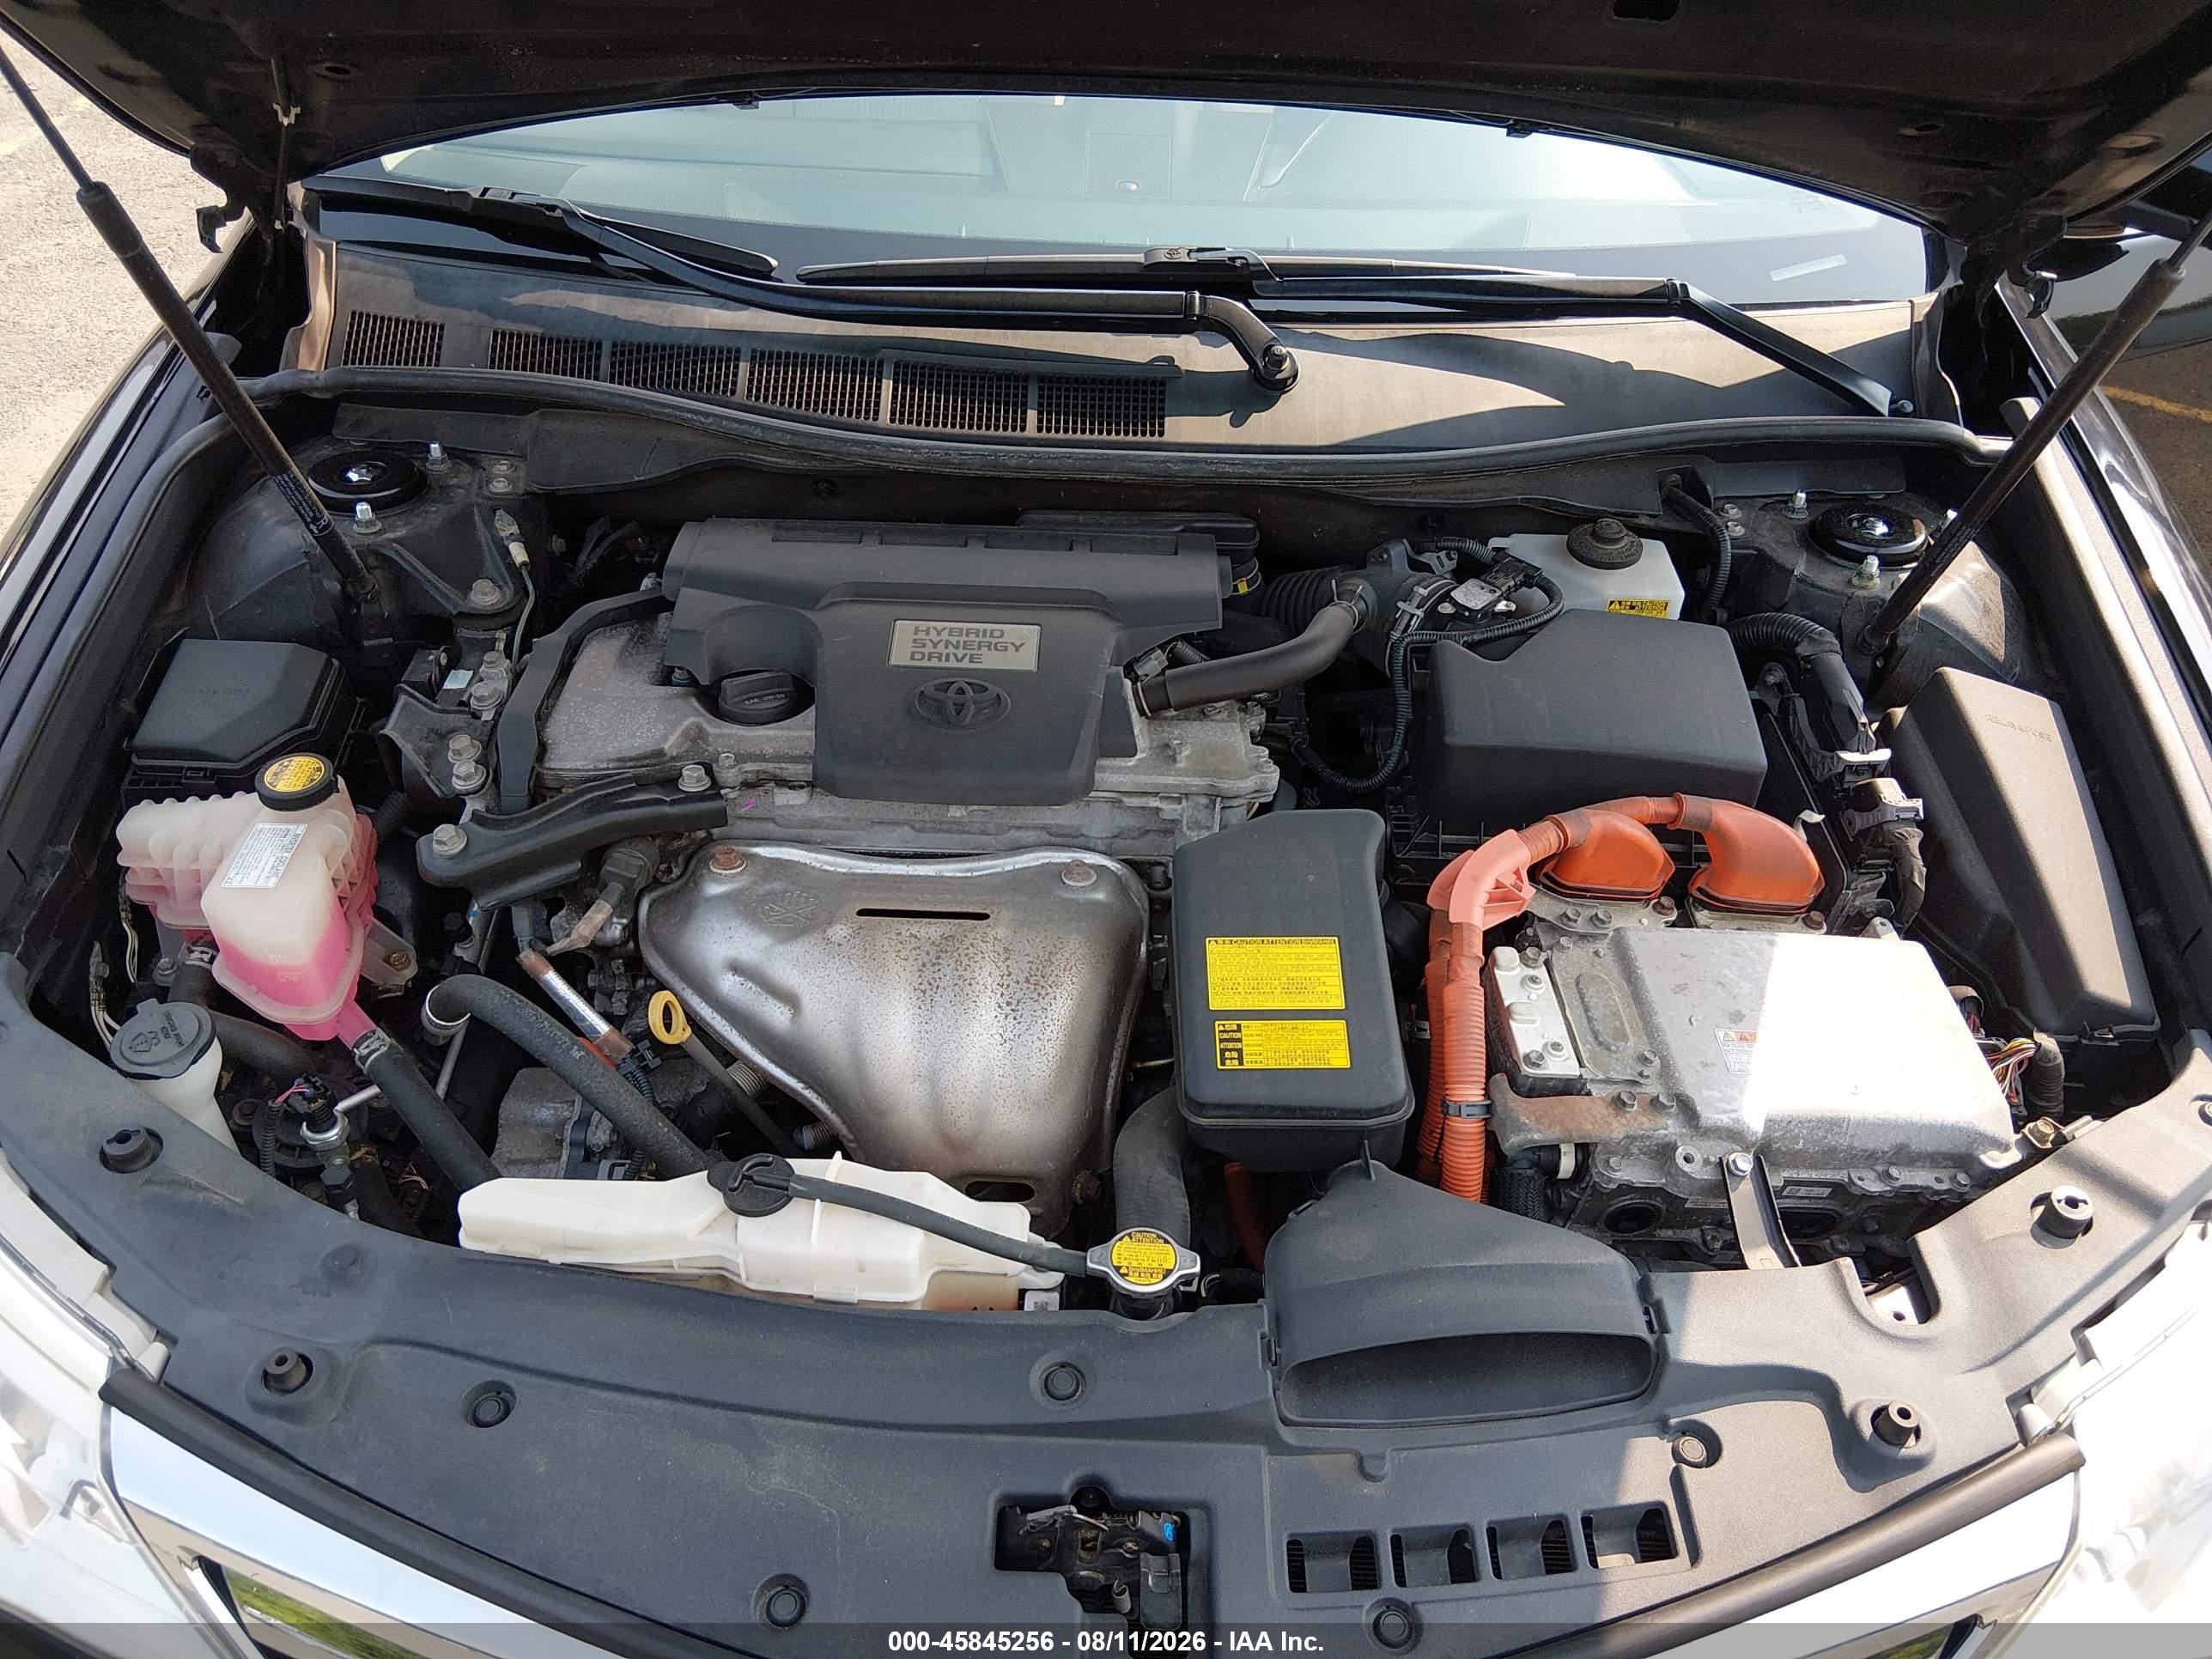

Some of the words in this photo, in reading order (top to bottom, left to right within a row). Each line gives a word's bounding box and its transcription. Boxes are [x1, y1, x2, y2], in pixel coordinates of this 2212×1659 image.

[913, 625, 1005, 639] HYBRID
[911, 638, 1026, 653] SYNERGY
[909, 651, 983, 664] DRIVE
